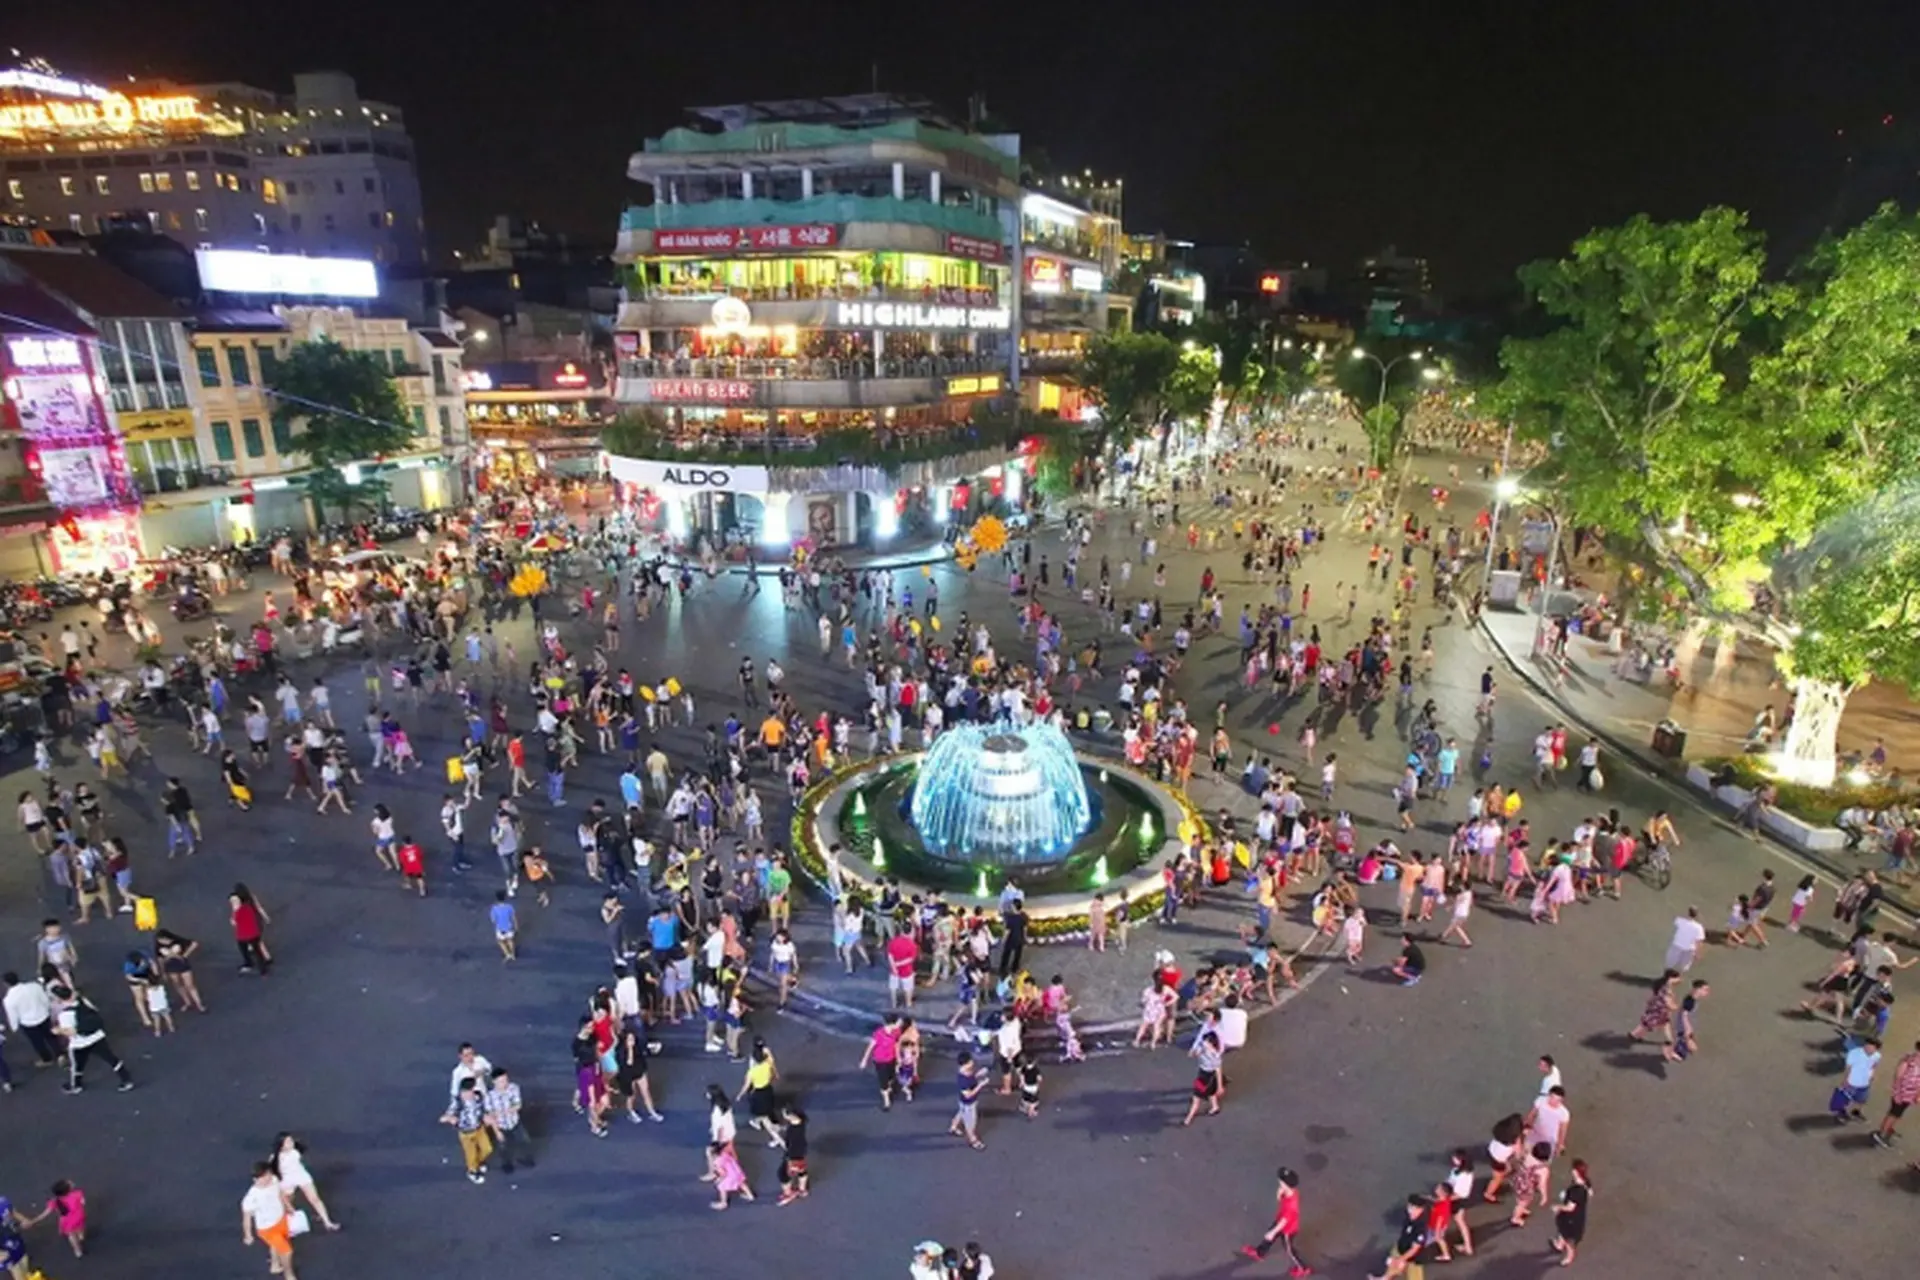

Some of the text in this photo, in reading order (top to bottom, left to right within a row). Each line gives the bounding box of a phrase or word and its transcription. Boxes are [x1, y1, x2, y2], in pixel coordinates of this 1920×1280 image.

[759, 228, 791, 249] 서울
[707, 381, 750, 398] BEER
[662, 467, 730, 487] ALDO
